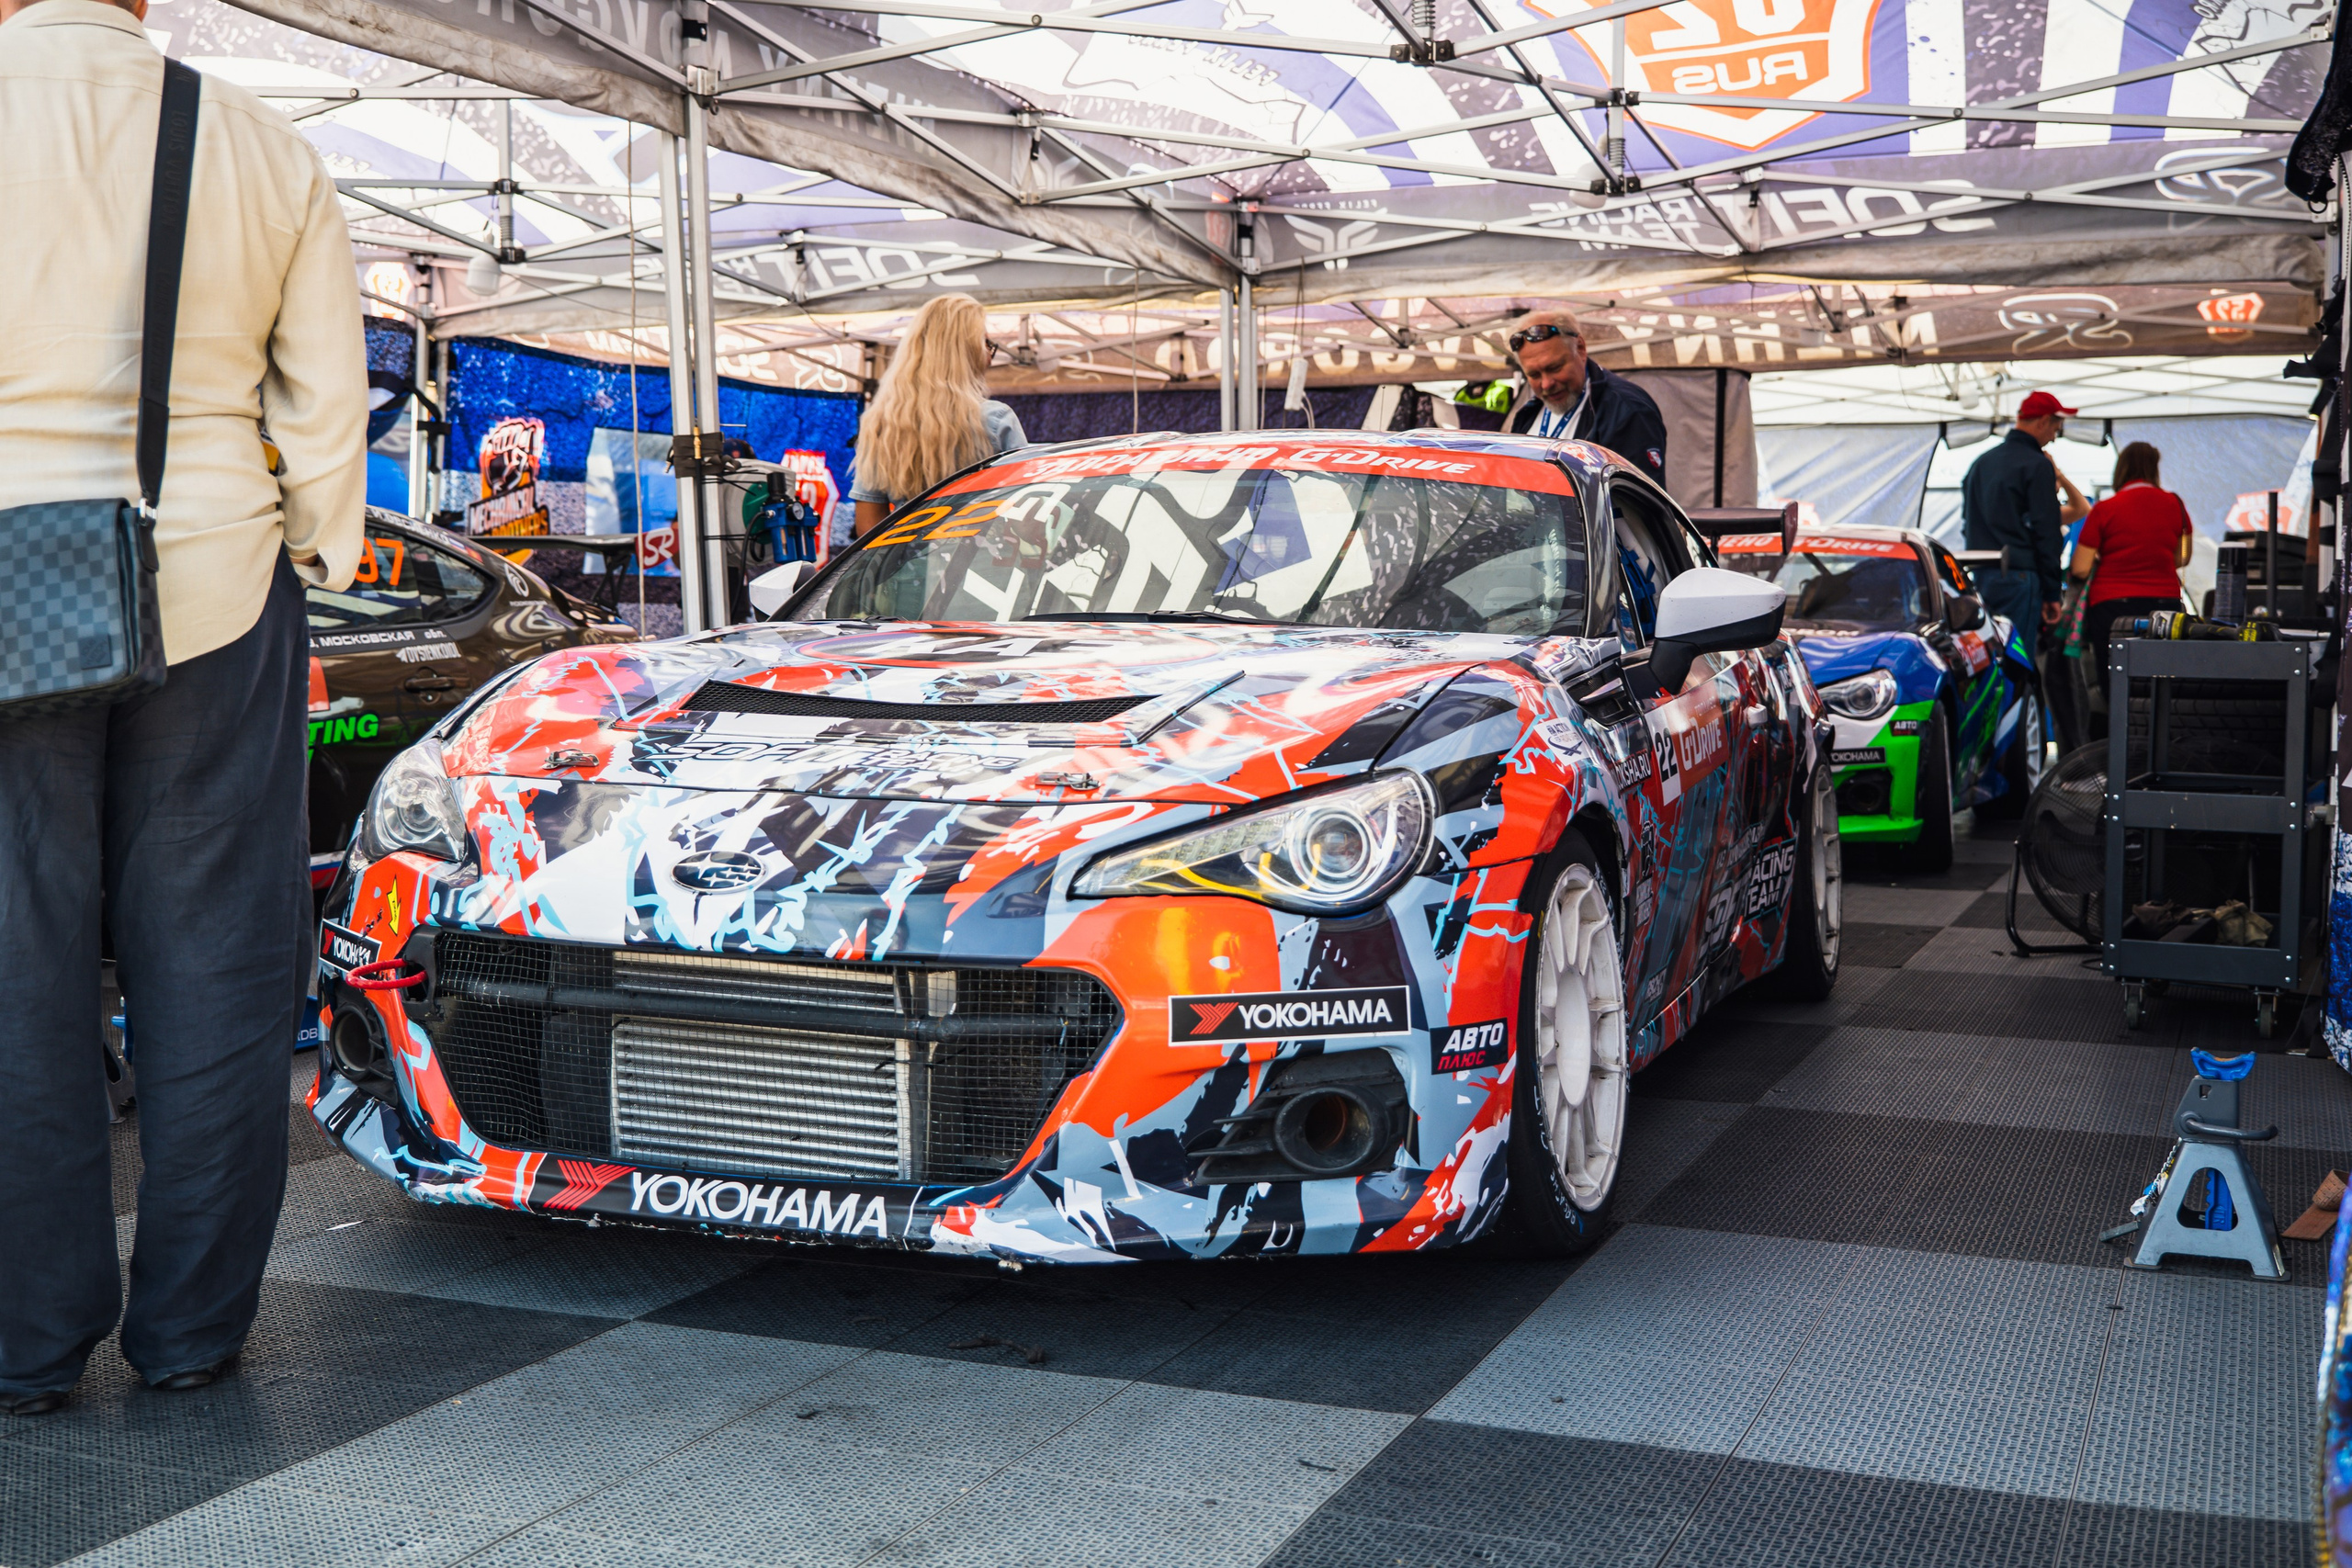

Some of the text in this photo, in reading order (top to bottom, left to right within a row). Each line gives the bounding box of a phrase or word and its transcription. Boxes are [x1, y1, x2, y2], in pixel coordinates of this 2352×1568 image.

[1023, 446, 1280, 479] ЗАПРАВЛЕНО
[863, 498, 1016, 550] 22
[355, 536, 405, 586] 97
[642, 526, 678, 568] SR
[320, 630, 416, 648] МОСКОВСКАЯ
[424, 628, 448, 640] обл.
[1655, 727, 1679, 784] 22
[1237, 998, 1394, 1030] YOKOHAMA
[1442, 1021, 1506, 1055] АВТО
[1437, 1050, 1487, 1071] ПЛЮС
[629, 1171, 888, 1239] YOKOHAMA
